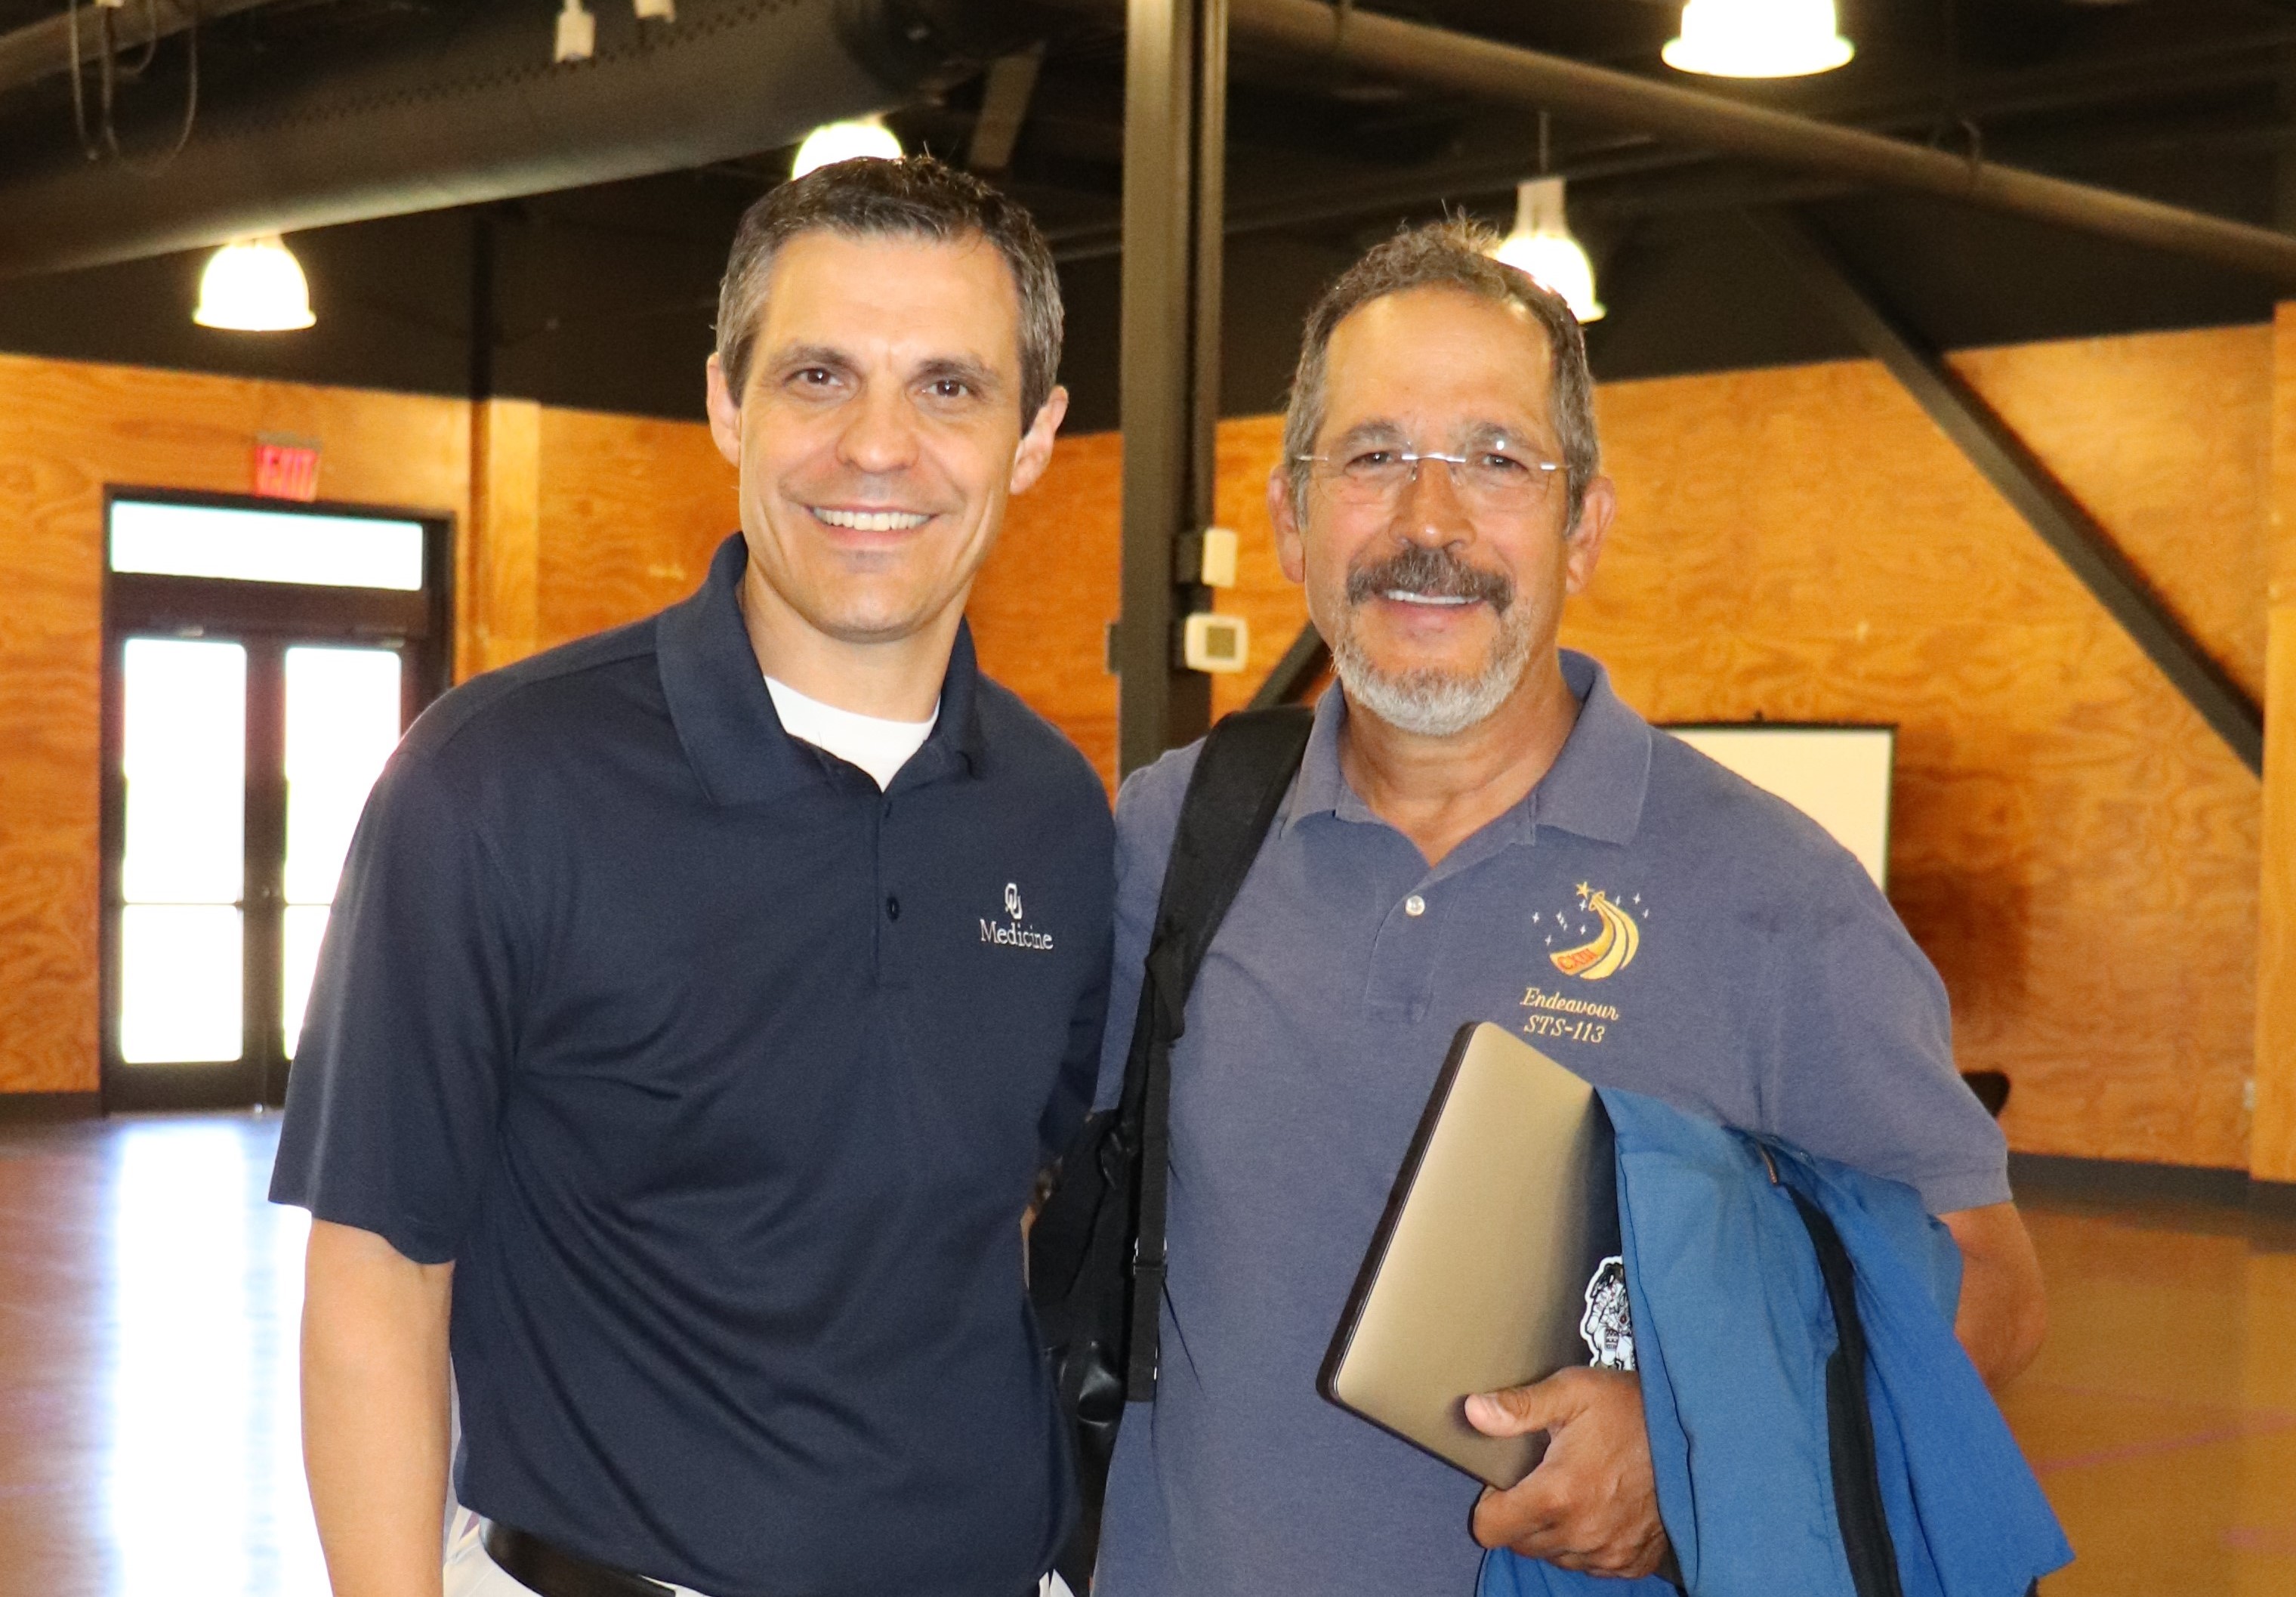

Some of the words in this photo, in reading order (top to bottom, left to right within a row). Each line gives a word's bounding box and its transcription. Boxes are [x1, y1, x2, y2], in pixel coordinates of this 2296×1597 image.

[980, 919, 1054, 950] Medicine
[1520, 987, 1619, 1021] Endeavour
[1524, 1015, 1606, 1043] STS-113
